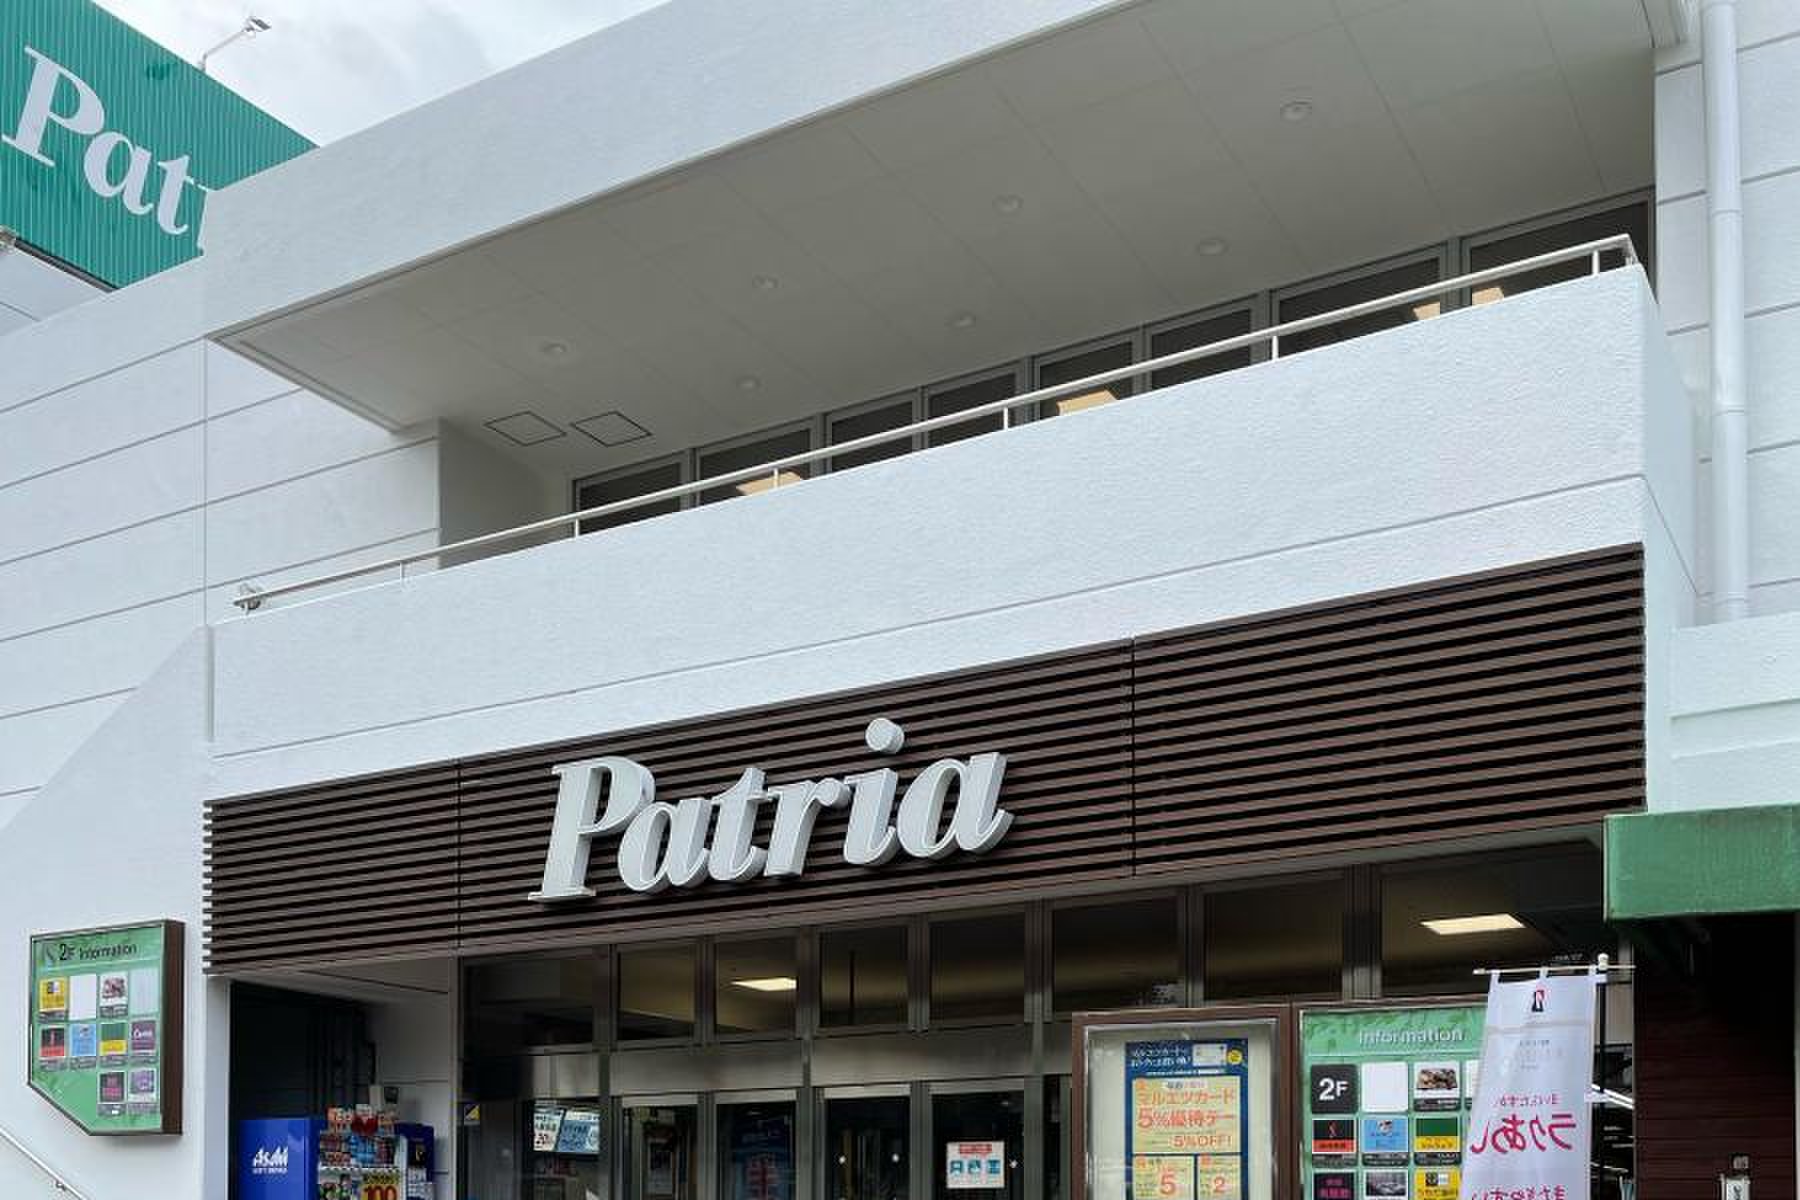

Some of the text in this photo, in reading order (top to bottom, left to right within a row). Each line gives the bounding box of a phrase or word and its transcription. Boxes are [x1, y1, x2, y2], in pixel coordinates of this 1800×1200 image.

[2, 46, 208, 235] Pat
[528, 717, 1015, 901] Patria
[1359, 1029, 1463, 1044] Information
[1319, 1077, 1348, 1101] 2F
